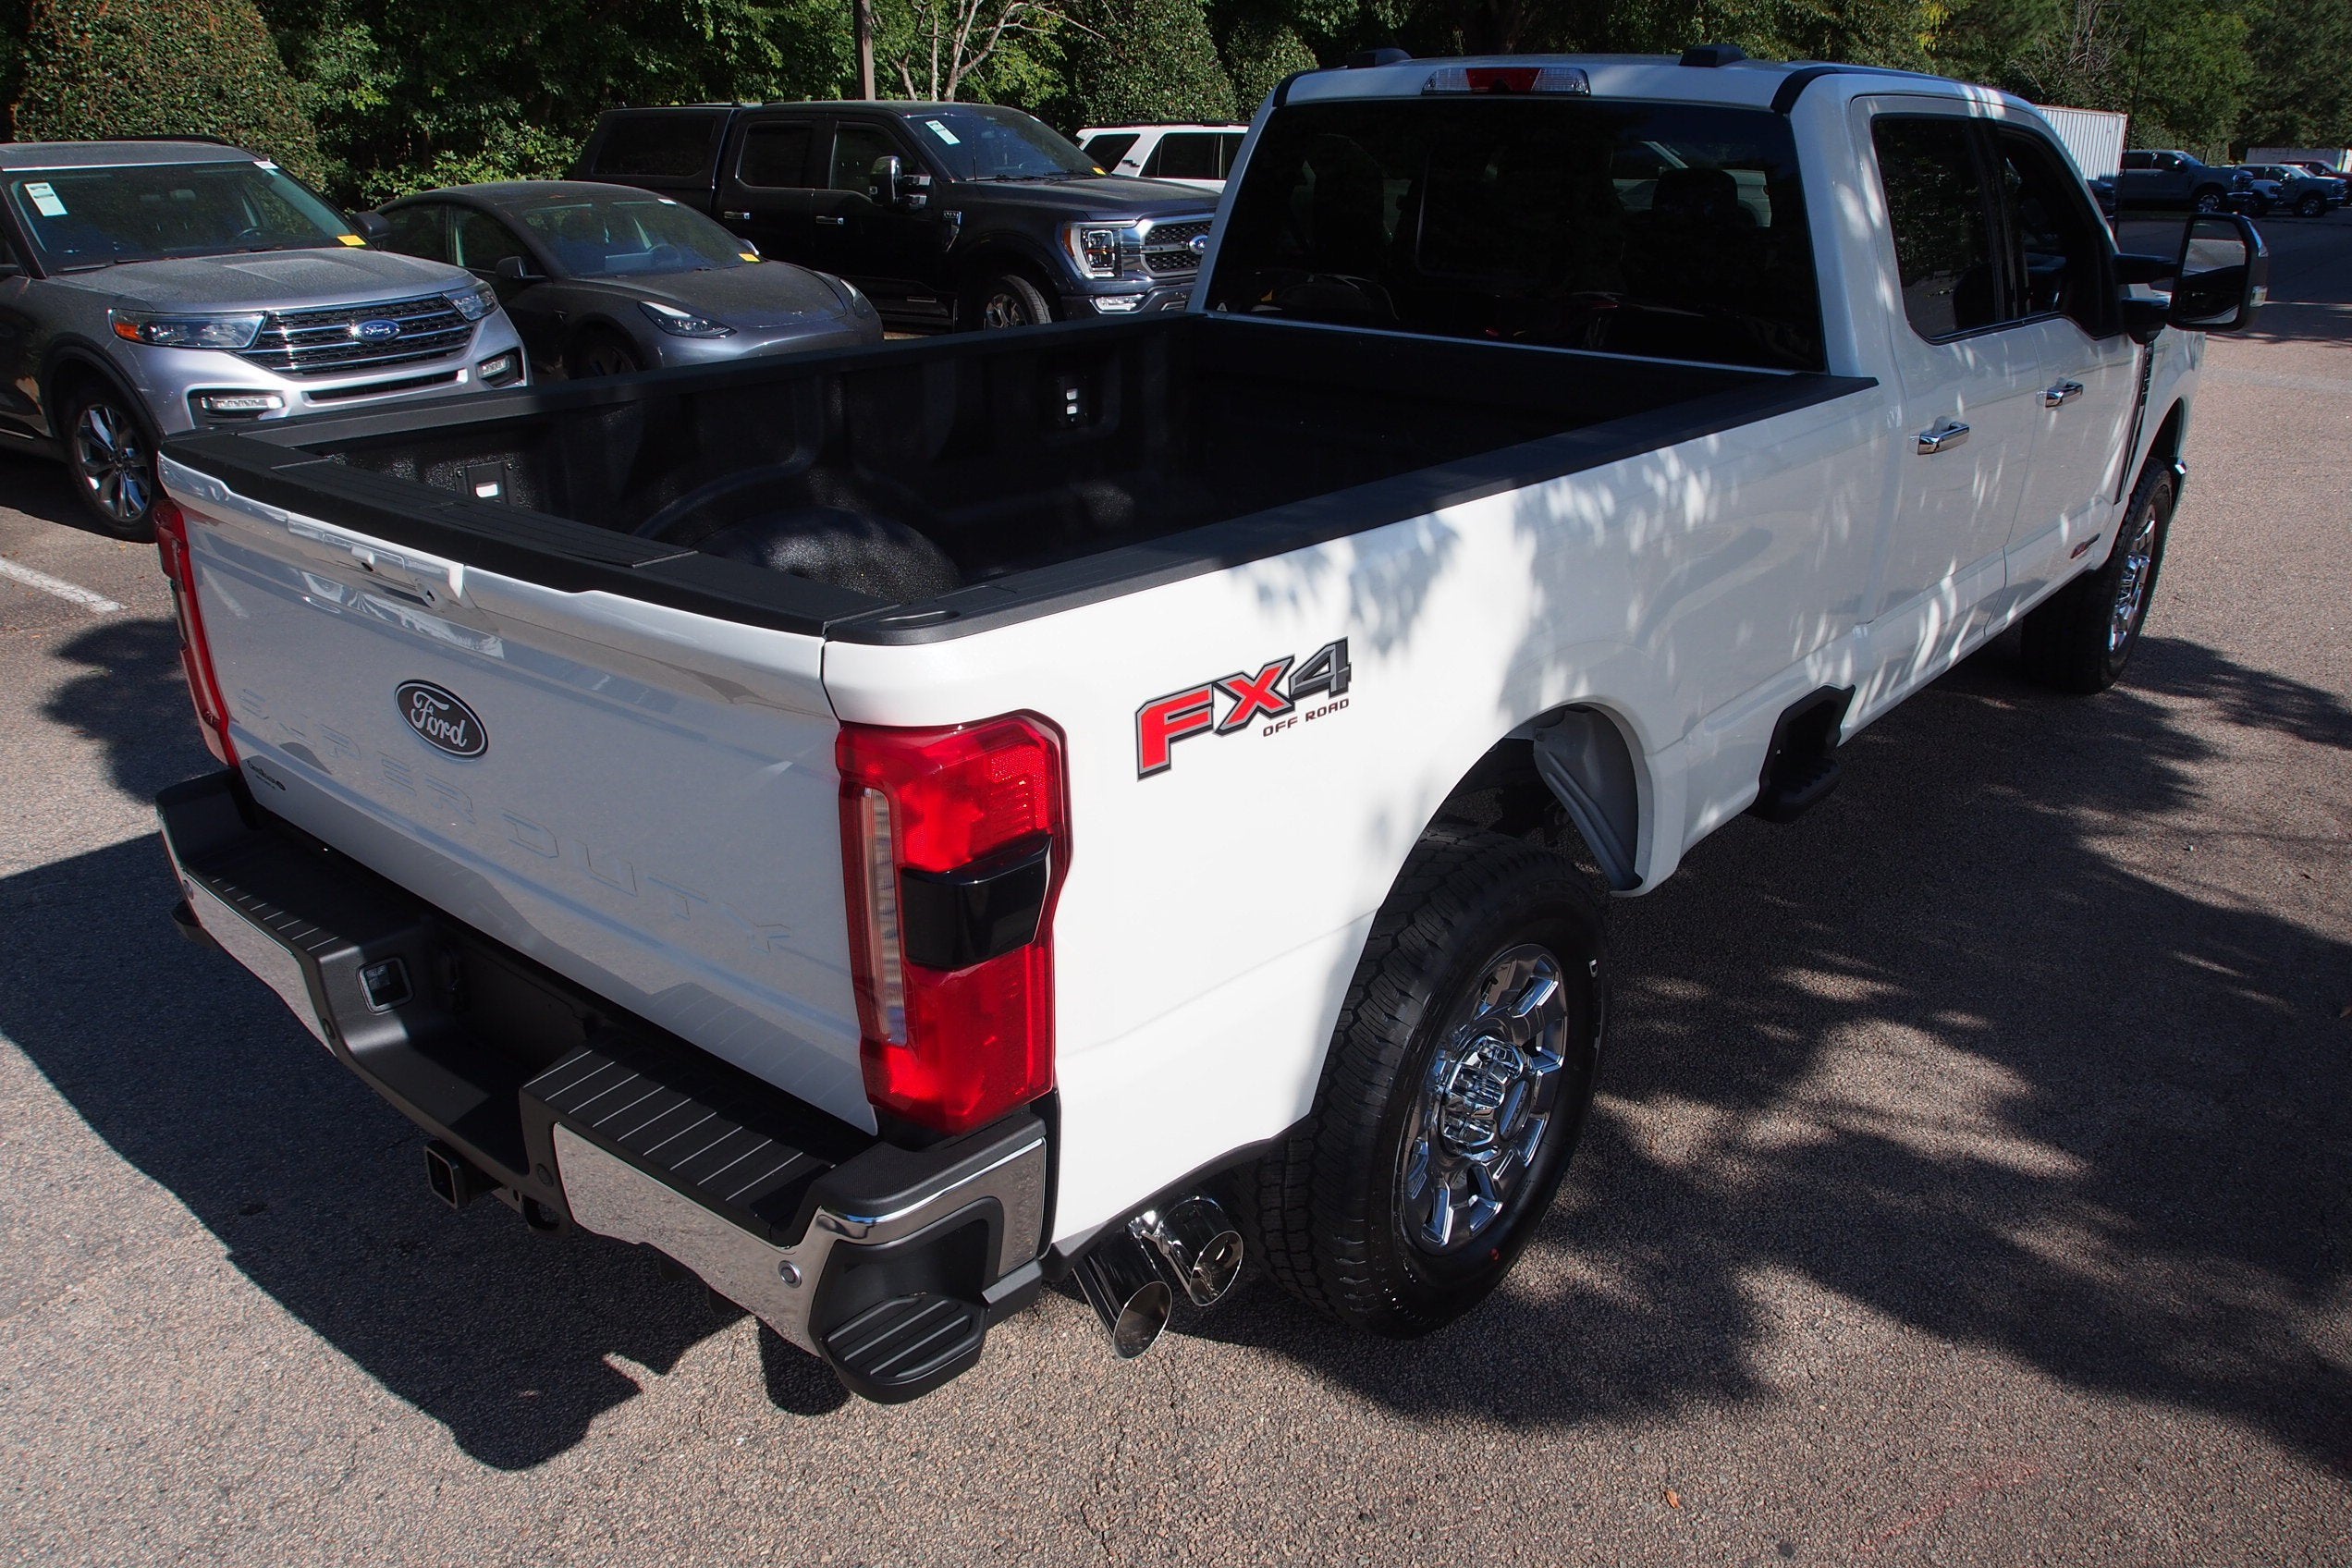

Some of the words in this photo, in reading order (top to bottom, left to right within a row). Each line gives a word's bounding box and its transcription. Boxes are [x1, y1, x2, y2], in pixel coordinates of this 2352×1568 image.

[410, 691, 468, 748] Ford
[1136, 637, 1352, 782] FX4
[1262, 716, 1298, 738] OFF
[1305, 697, 1350, 723] ROAD
[502, 808, 791, 952] DUTY
